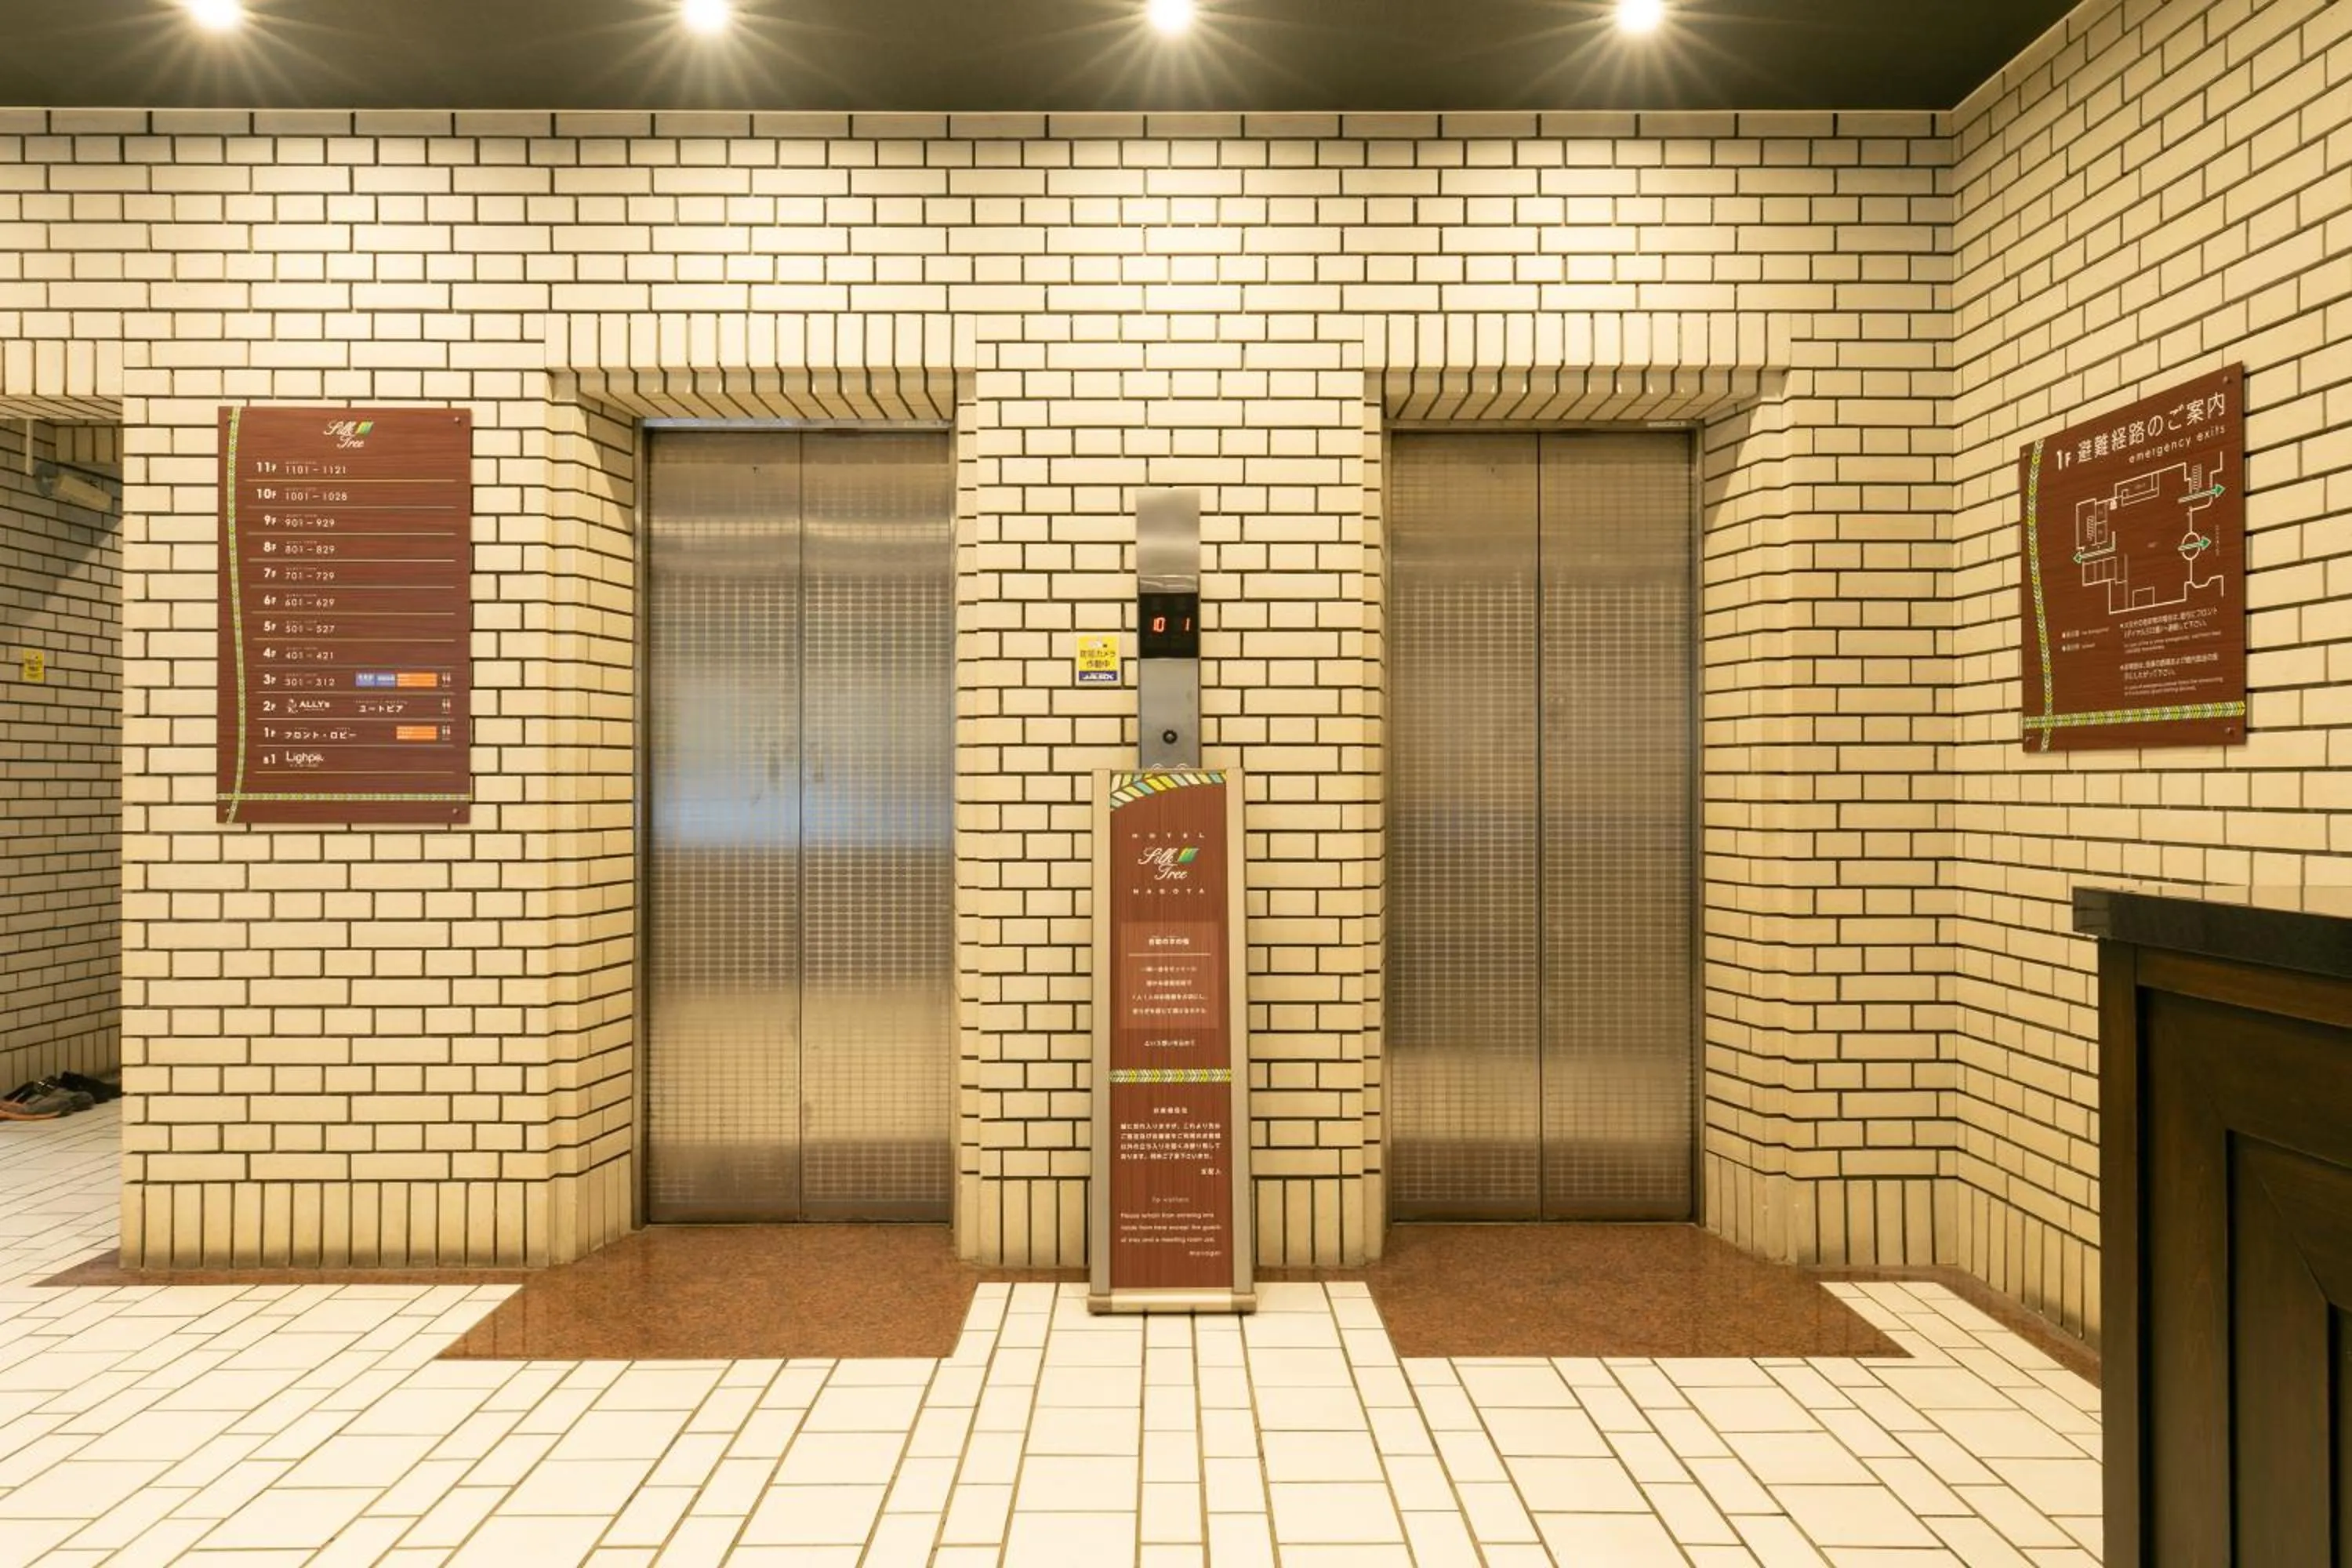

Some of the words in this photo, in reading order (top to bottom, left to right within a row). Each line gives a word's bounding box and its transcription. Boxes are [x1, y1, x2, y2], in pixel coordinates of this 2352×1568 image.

[323, 421, 357, 436] Silk
[2056, 449, 2071, 470] 1F
[2077, 391, 2225, 464] 避難経路のご案内
[336, 435, 365, 448] Tree
[2129, 436, 2192, 464] emergency
[2197, 424, 2226, 441] exits
[286, 466, 309, 474] 1101
[285, 519, 303, 528] 901
[285, 546, 303, 554] 801
[1153, 617, 1165, 632] 10
[1185, 618, 1190, 631] 1
[1138, 847, 1178, 866] Silk
[1154, 864, 1188, 880] Tree
